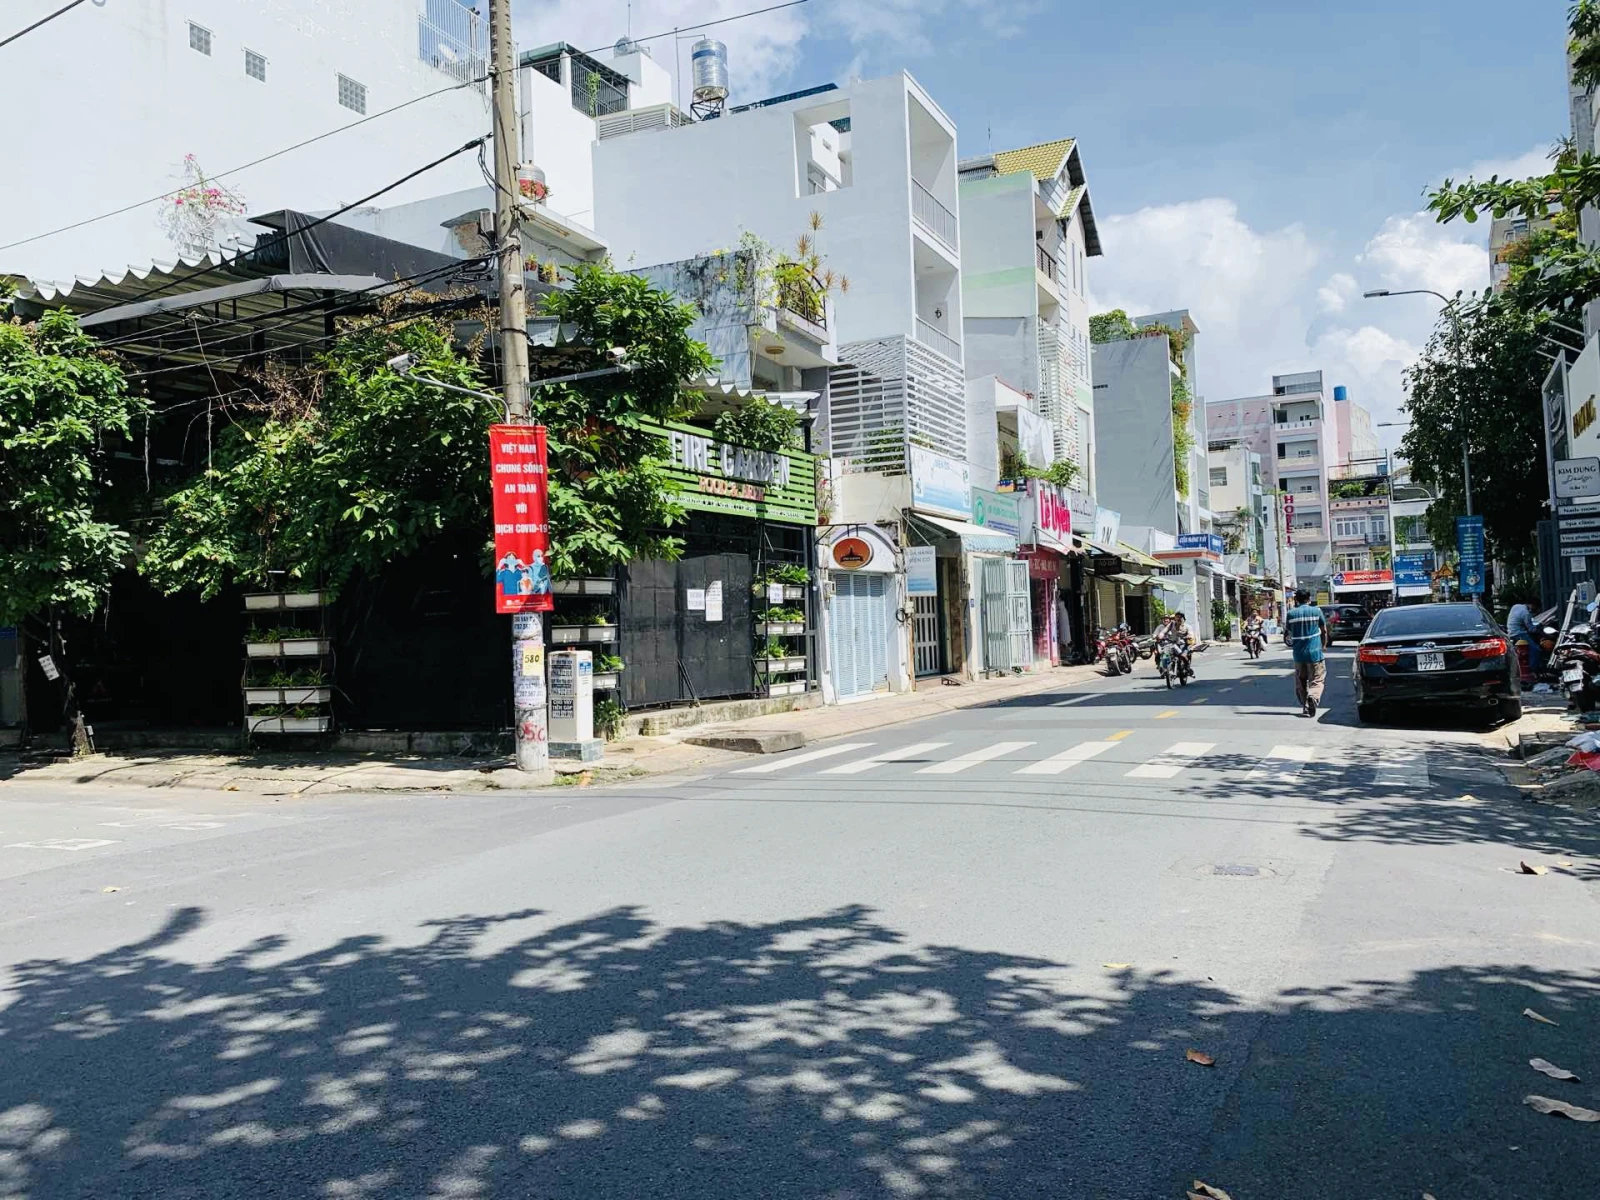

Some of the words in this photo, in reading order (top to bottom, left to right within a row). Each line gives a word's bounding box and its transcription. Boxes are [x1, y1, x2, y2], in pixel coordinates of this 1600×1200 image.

[501, 443, 517, 455] VIỆT
[518, 444, 537, 454] NAM
[495, 463, 521, 474] CHUNG
[522, 461, 544, 474] SỐNG
[504, 483, 516, 494] AN
[517, 482, 537, 494] TOÀN
[515, 502, 527, 514] VỚI
[495, 524, 514, 535] DỊCH
[515, 523, 548, 534] COVID-19
[525, 654, 540, 664] 580
[1424, 654, 1438, 662] 15A
